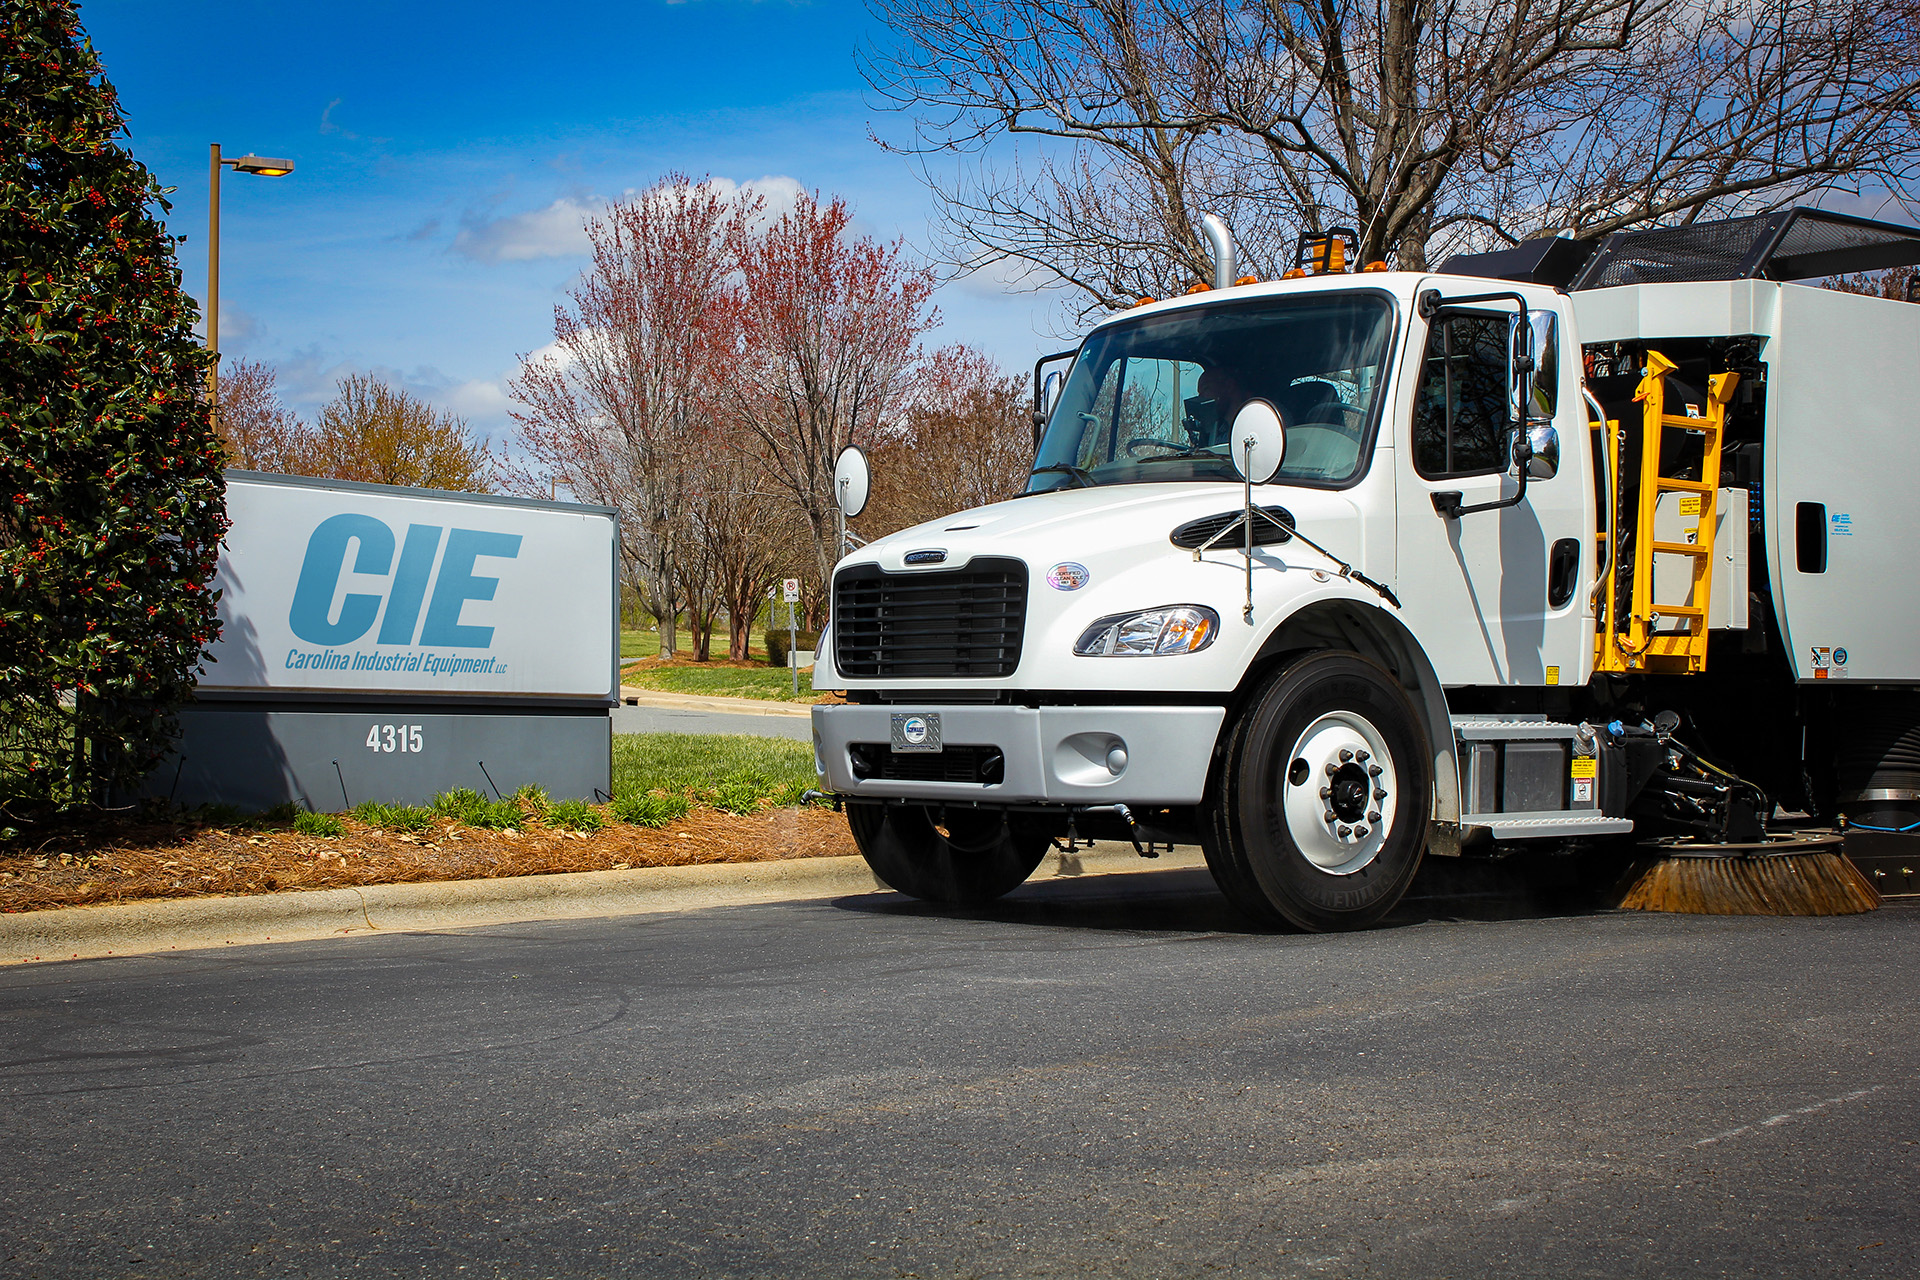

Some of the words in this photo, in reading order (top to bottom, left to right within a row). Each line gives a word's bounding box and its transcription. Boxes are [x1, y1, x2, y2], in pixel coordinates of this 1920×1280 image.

[289, 513, 523, 648] CIE
[285, 648, 350, 670] Carolina
[351, 650, 424, 672] Industrial
[423, 653, 496, 677] Equipment
[494, 663, 508, 674] LLC
[366, 724, 424, 753] 4315
